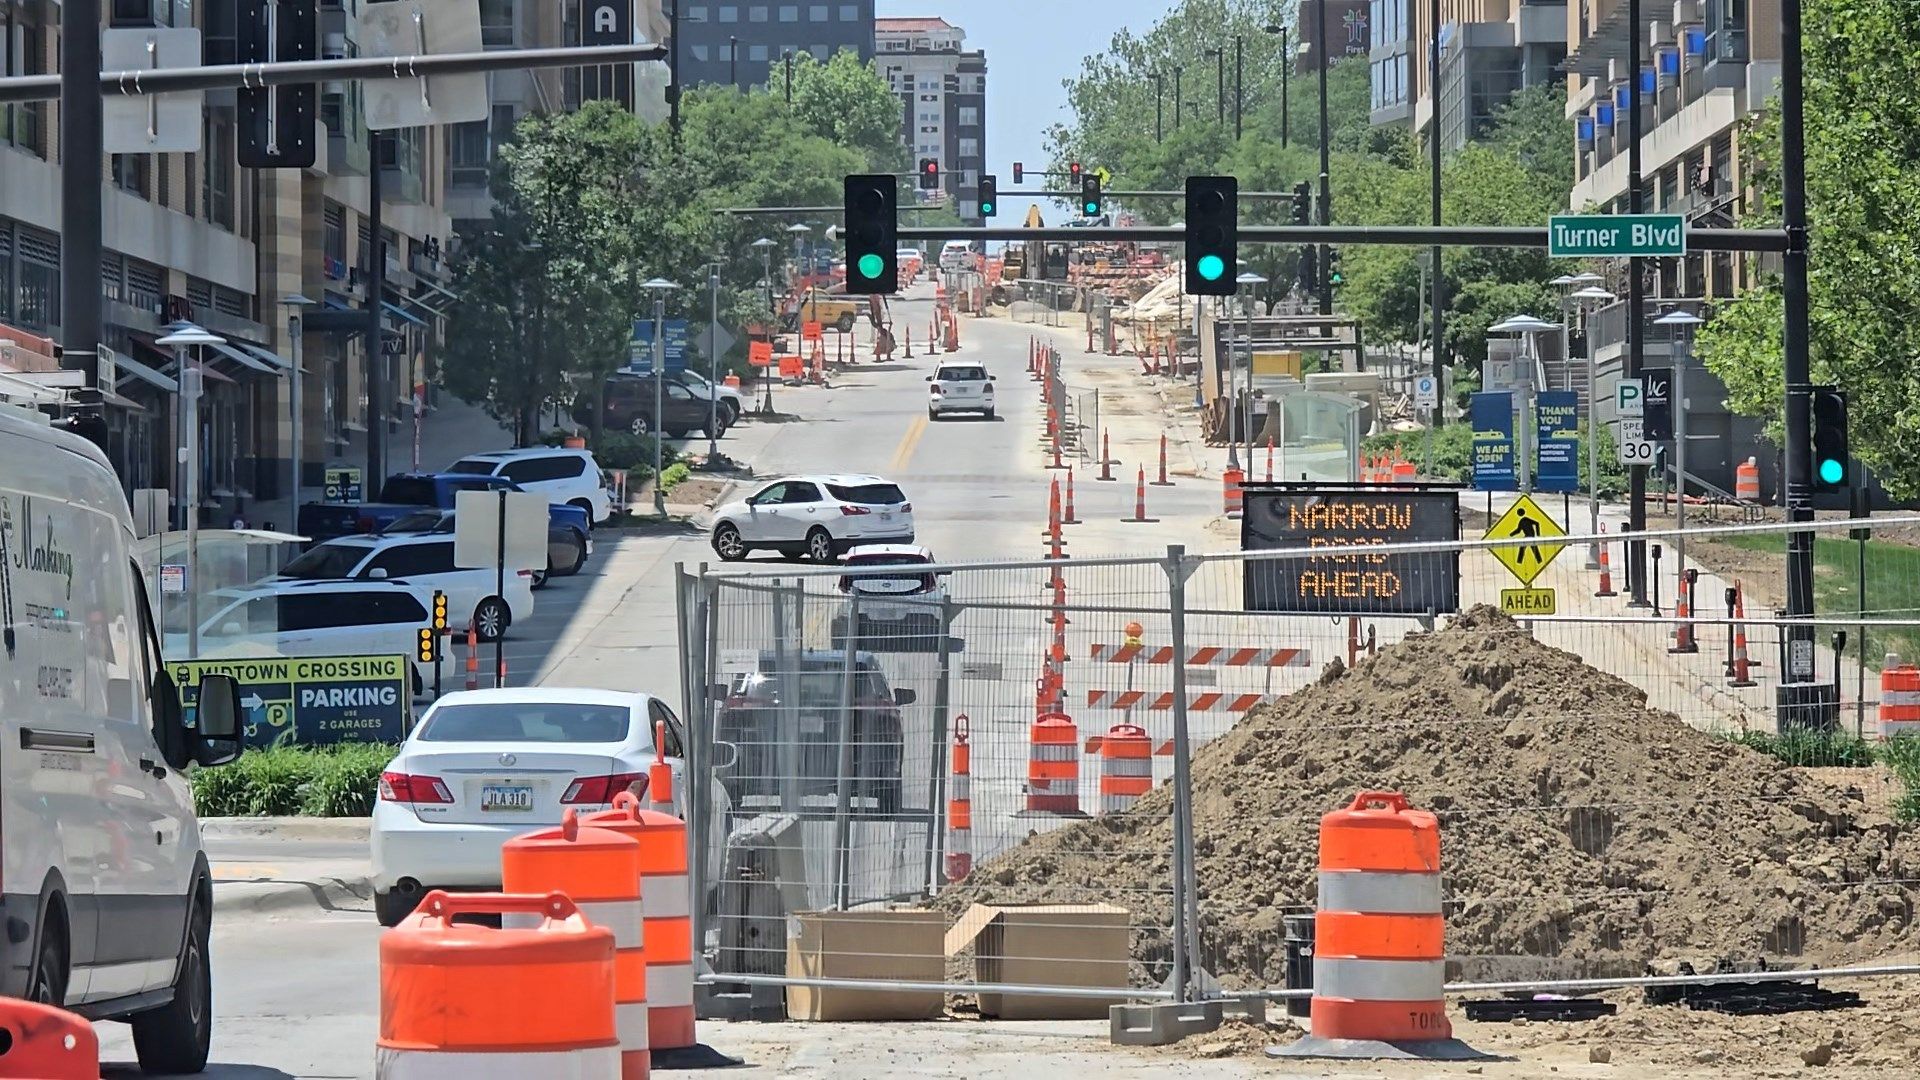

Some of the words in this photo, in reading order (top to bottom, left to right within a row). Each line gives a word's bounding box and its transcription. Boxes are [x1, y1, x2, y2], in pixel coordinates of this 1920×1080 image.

[594, 5, 617, 32] A
[1345, 45, 1365, 54] First
[1554, 224, 1620, 248] Turner
[1631, 223, 1680, 247] Blvd
[1540, 406, 1575, 415] THANK
[1540, 415, 1562, 425] YOU
[1622, 422, 1644, 430] SPE
[1625, 431, 1644, 440] LIM
[1475, 445, 1491, 454] WE
[1492, 445, 1510, 454] ARE
[1624, 442, 1651, 459] 30
[1475, 454, 1504, 463] OPEN
[1289, 503, 1411, 530] NARROW
[13, 495, 74, 601] Marking
[1299, 571, 1401, 598] AHEAD
[1506, 594, 1551, 609] AHEAD
[297, 660, 396, 679] CROSSING
[301, 686, 397, 708] PARKING
[343, 709, 358, 717] USE
[319, 720, 326, 730] 2
[329, 718, 382, 729] GARAGES
